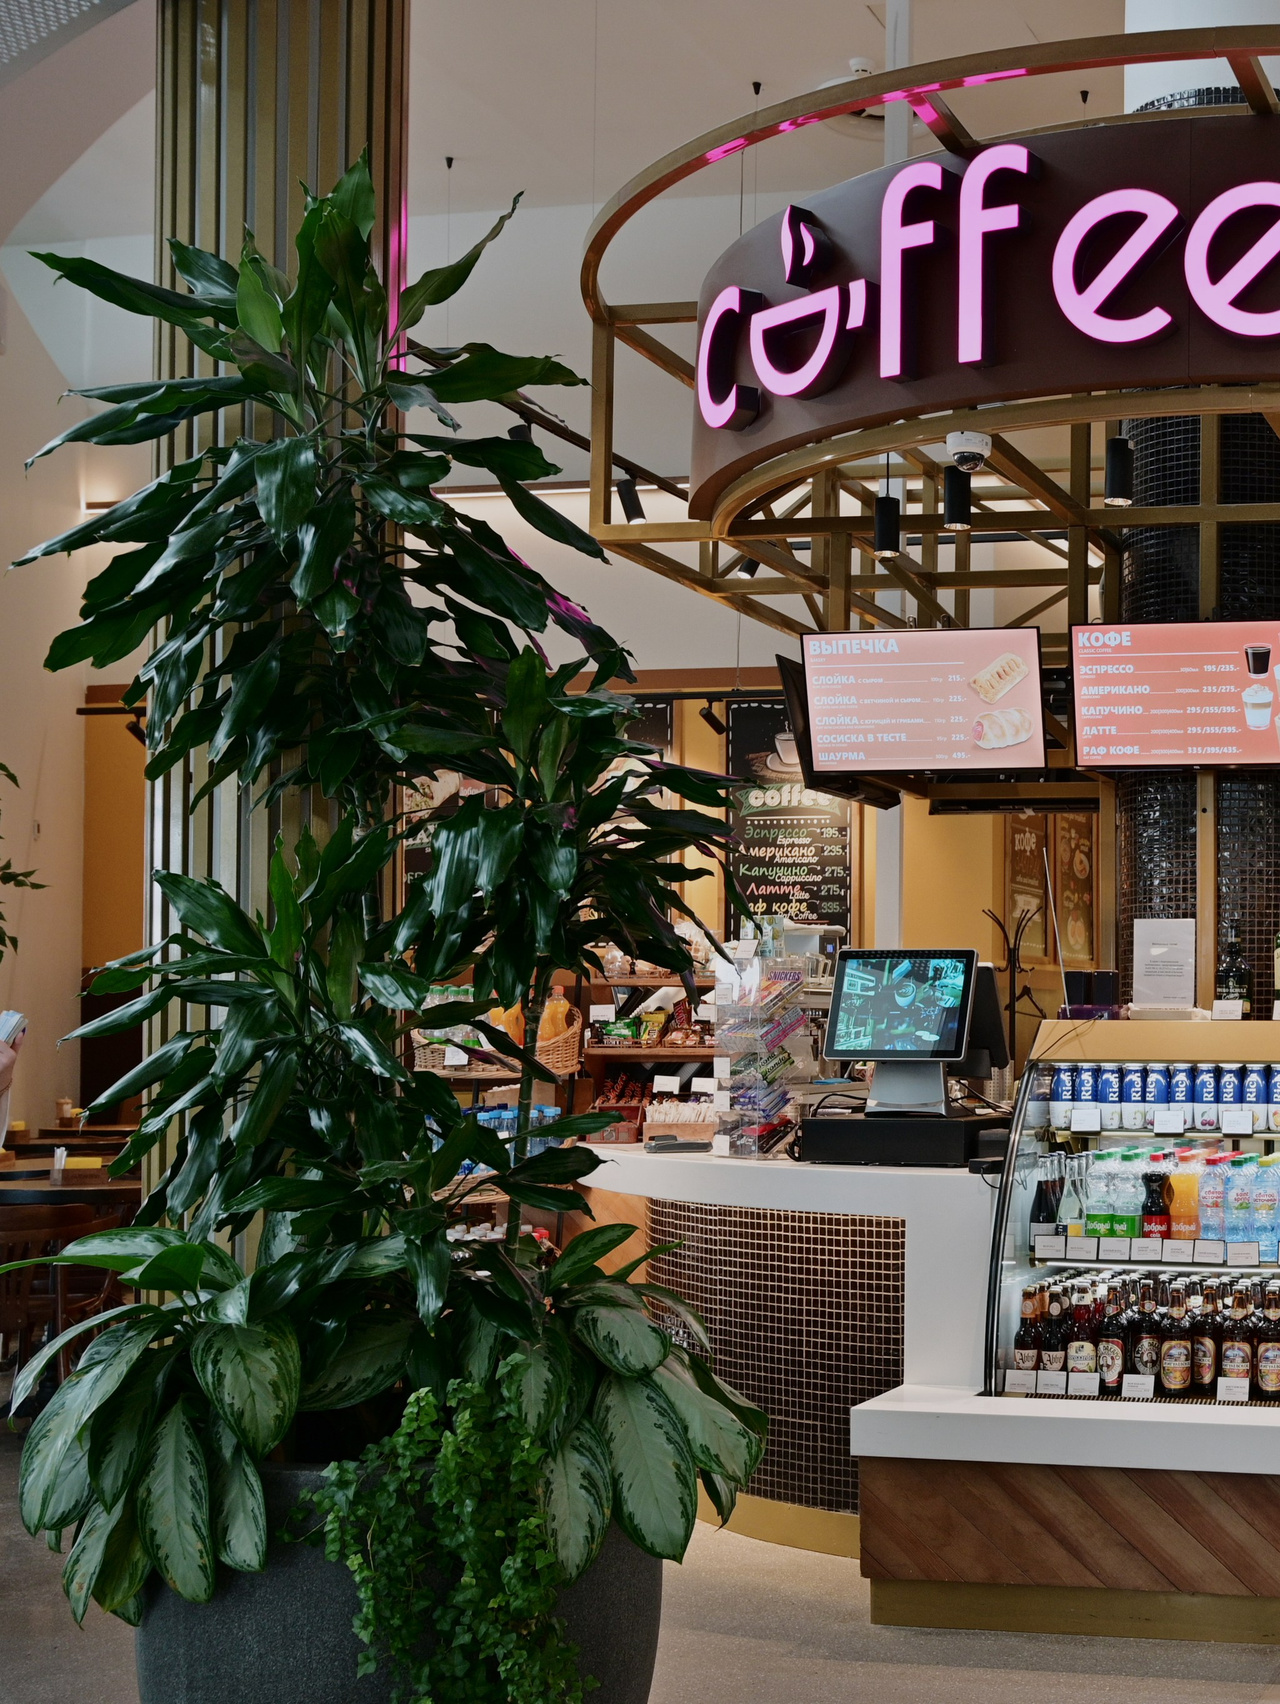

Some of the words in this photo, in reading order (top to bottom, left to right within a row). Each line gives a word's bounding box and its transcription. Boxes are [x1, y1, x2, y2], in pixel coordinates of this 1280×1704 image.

[1078, 631, 1132, 647] КОФЕ
[809, 639, 899, 655] ВЫПЕЧКА
[1080, 664, 1134, 674] ЭСПРЕССО
[812, 673, 855, 684] СЛОЙКА
[1081, 685, 1150, 695] АМЕРИКАНО
[814, 693, 857, 705] СЛОЙКА
[1081, 706, 1143, 715] КАПУЧИНО
[816, 714, 859, 725] СЛОЙКА
[1083, 726, 1117, 735] ЛАТТЕ
[817, 734, 865, 743] СОСИСКА
[867, 734, 874, 742] В
[877, 733, 907, 742] ТЕСТЕ
[818, 752, 866, 761] ШАУРМА
[1083, 746, 1107, 755] РАФ
[1110, 746, 1140, 755] КОФЕ
[749, 784, 833, 807] coffee
[744, 826, 807, 842] Эспрессо
[777, 836, 812, 846] Espresso
[739, 864, 807, 879] Капучино
[775, 873, 823, 884] Cappuccino
[747, 898, 766, 916] аф
[772, 898, 807, 916] кофе
[768, 971, 802, 981] SNICKERS
[1062, 1071, 1072, 1099] Rich
[1081, 1072, 1092, 1099] Rich
[1109, 1073, 1119, 1101] Rich
[1132, 1073, 1141, 1101] Rich
[1175, 1073, 1186, 1100] Rich
[1203, 1073, 1214, 1101] Rich
[1223, 1073, 1234, 1101] Rich
[1247, 1073, 1257, 1101] Rich
[1143, 1222, 1168, 1232] Добрый
[1171, 1222, 1196, 1232] Добрый
